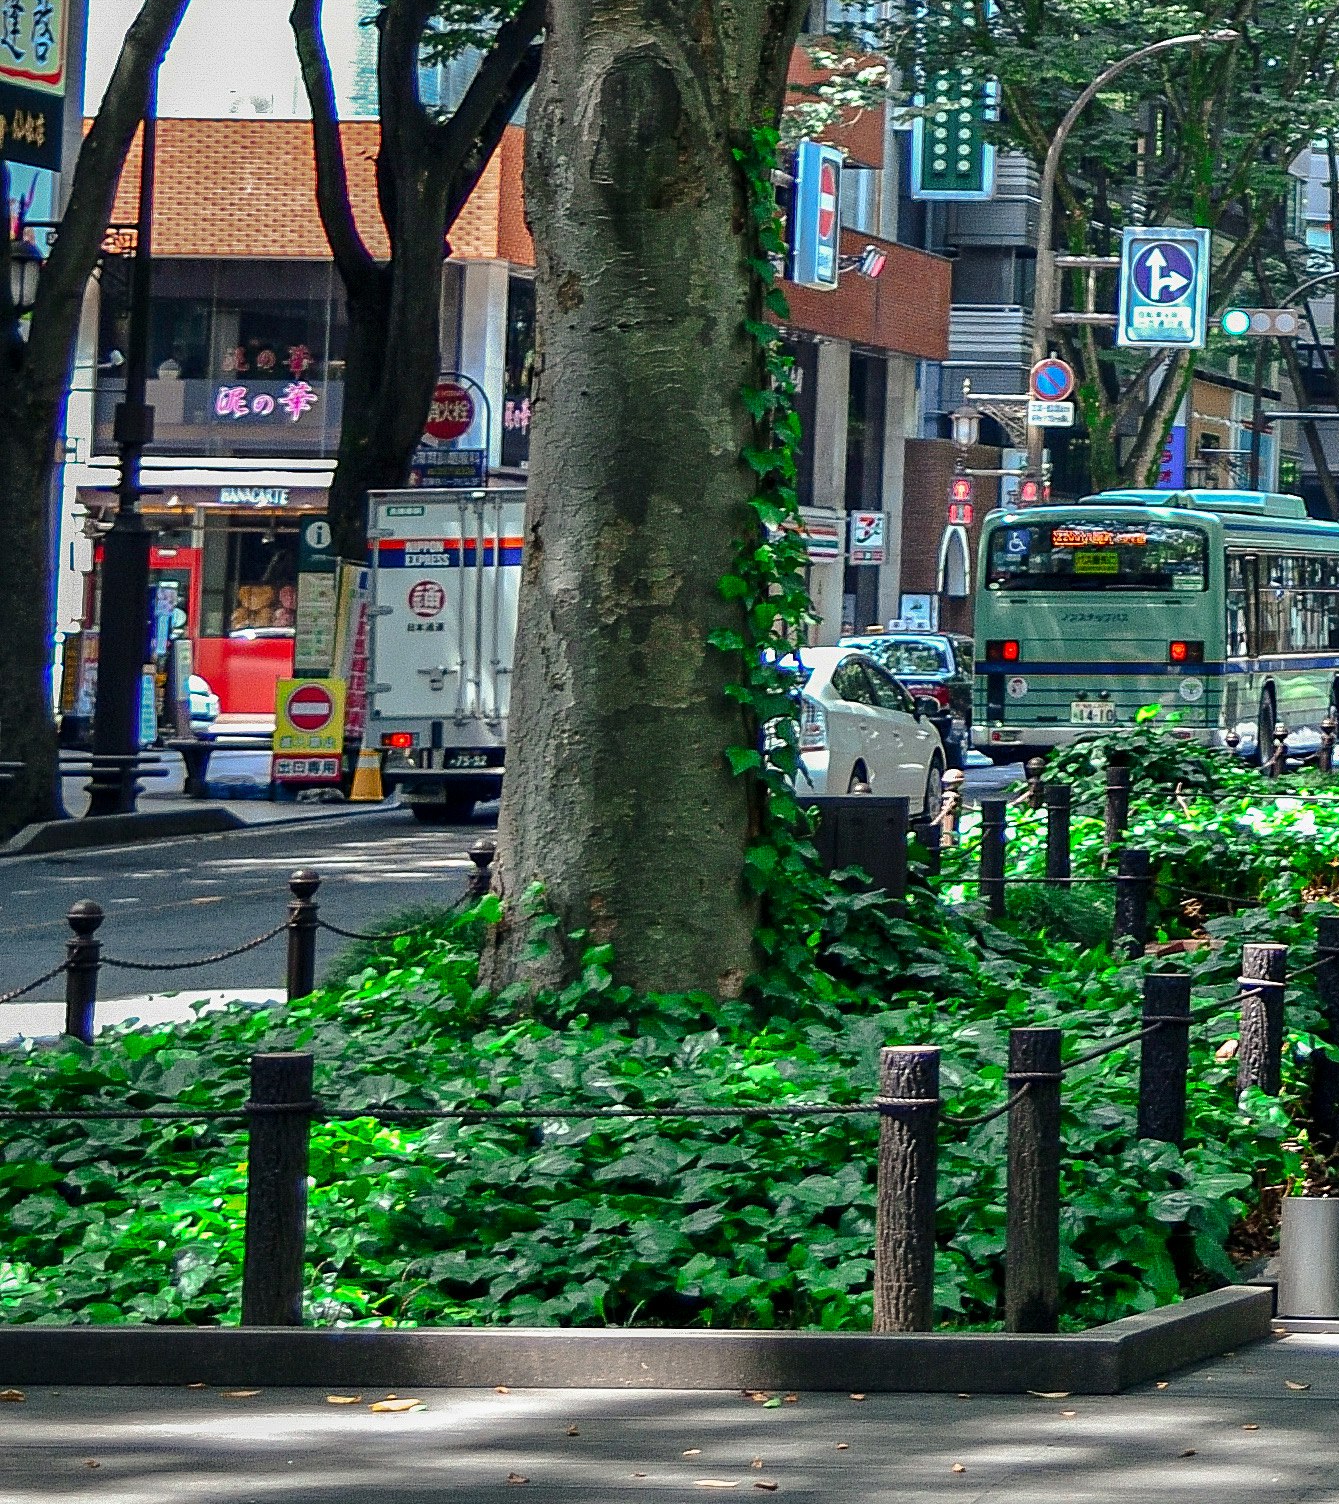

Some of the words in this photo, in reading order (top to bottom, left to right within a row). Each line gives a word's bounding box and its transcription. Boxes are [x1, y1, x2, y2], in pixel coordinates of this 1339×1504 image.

[215, 381, 318, 422] 泥の華
[405, 554, 449, 566] EXPRESS
